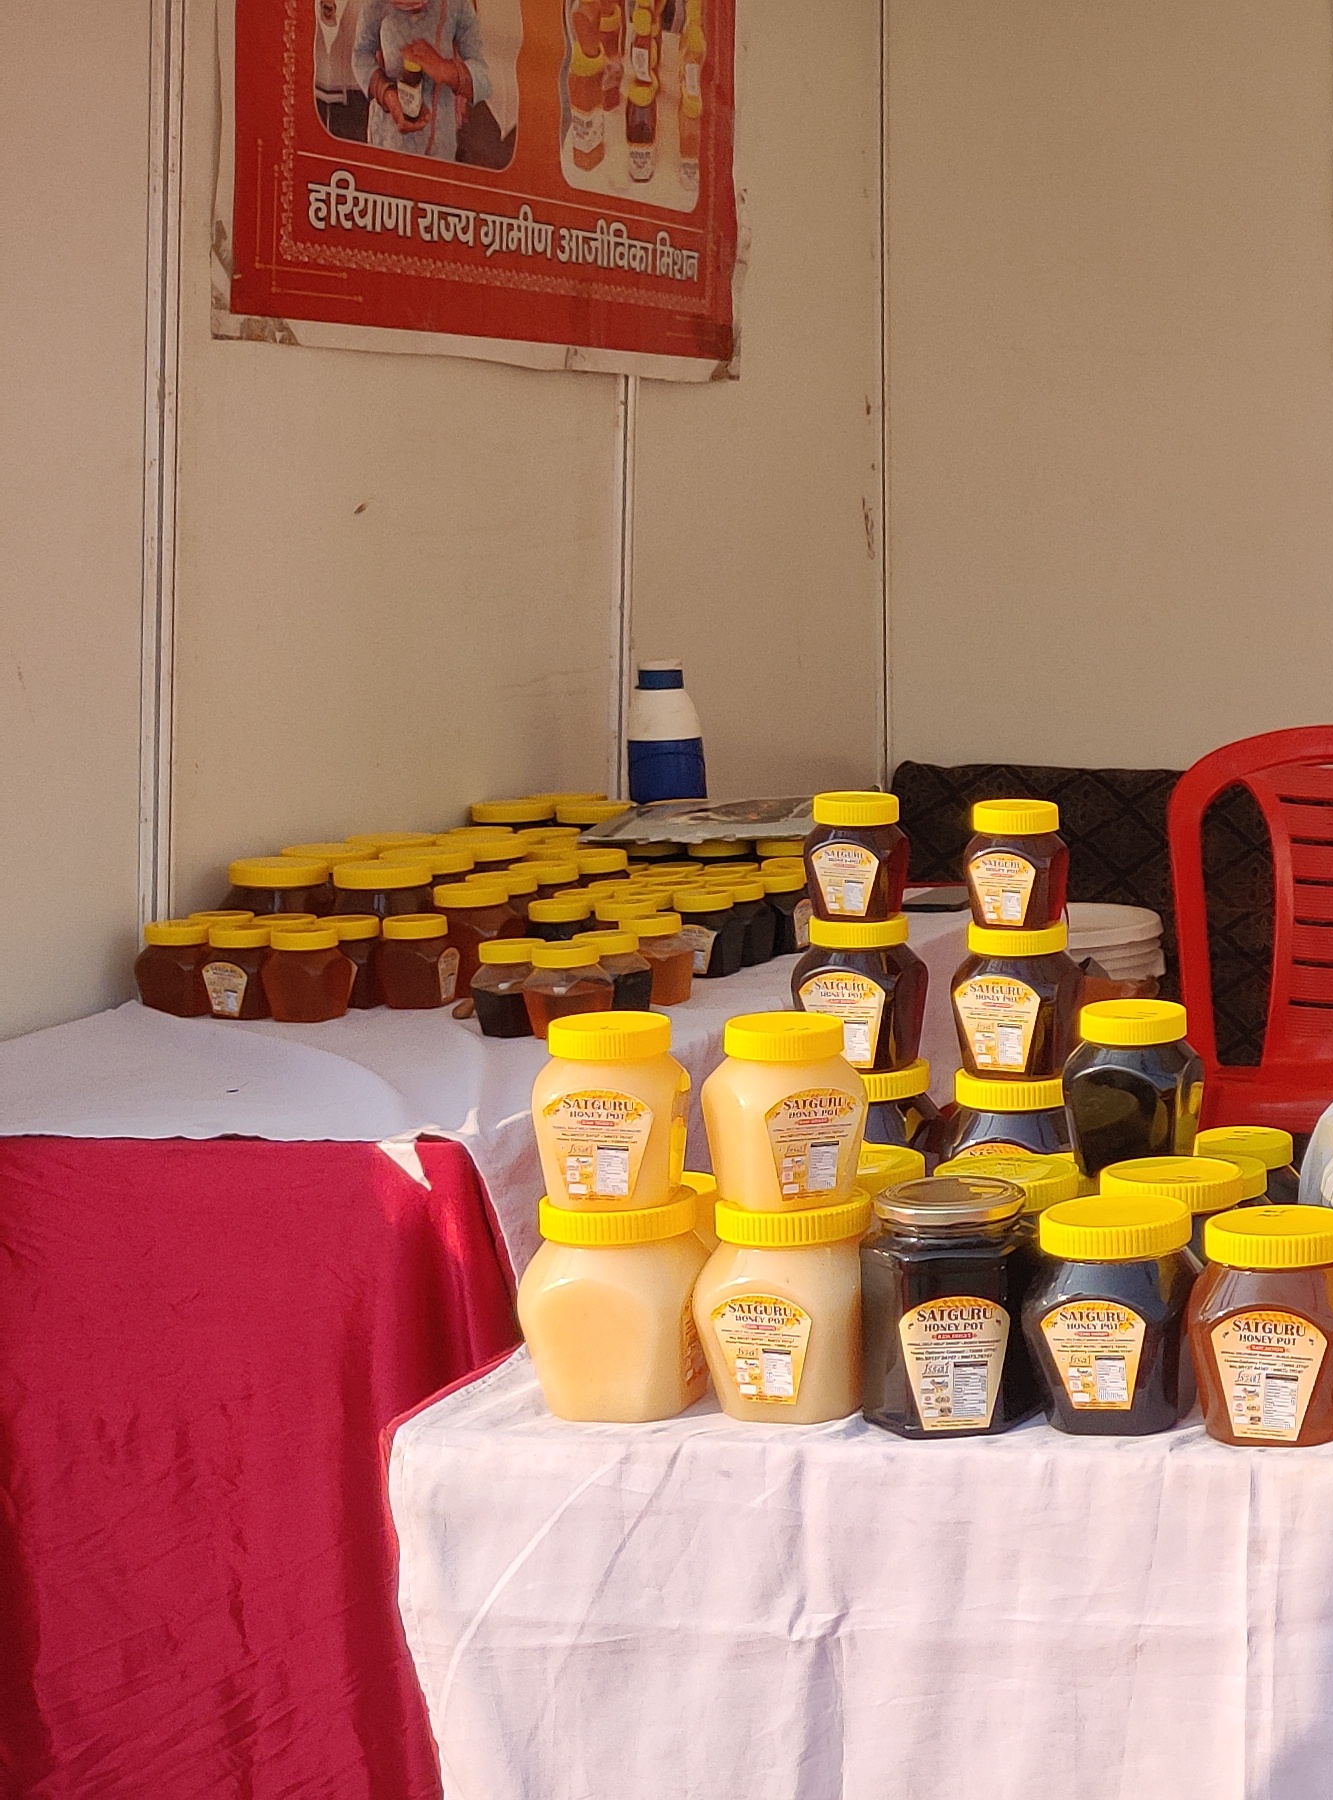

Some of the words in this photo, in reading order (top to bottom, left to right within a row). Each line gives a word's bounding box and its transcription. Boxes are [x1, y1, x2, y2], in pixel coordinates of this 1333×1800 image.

[307, 170, 412, 236] हरियाणा
[418, 198, 475, 247] राज्य
[479, 205, 552, 261] ग्रामीण
[556, 220, 653, 278] आजीविका
[655, 231, 698, 283] मिशन
[563, 1097, 634, 1112] SATGURU
[728, 1302, 792, 1317] SATGURU
[916, 1307, 994, 1322] SATGURU
[1059, 1311, 1126, 1322] SATGURU
[924, 1323, 960, 1332] HONEY
[963, 1322, 984, 1331] POT
[1066, 1322, 1098, 1330] HONEY
[1100, 1322, 1118, 1331] POT
[1232, 1320, 1306, 1337] SATGURU
[1239, 1335, 1272, 1345] HONEY
[1276, 1336, 1297, 1346] POT
